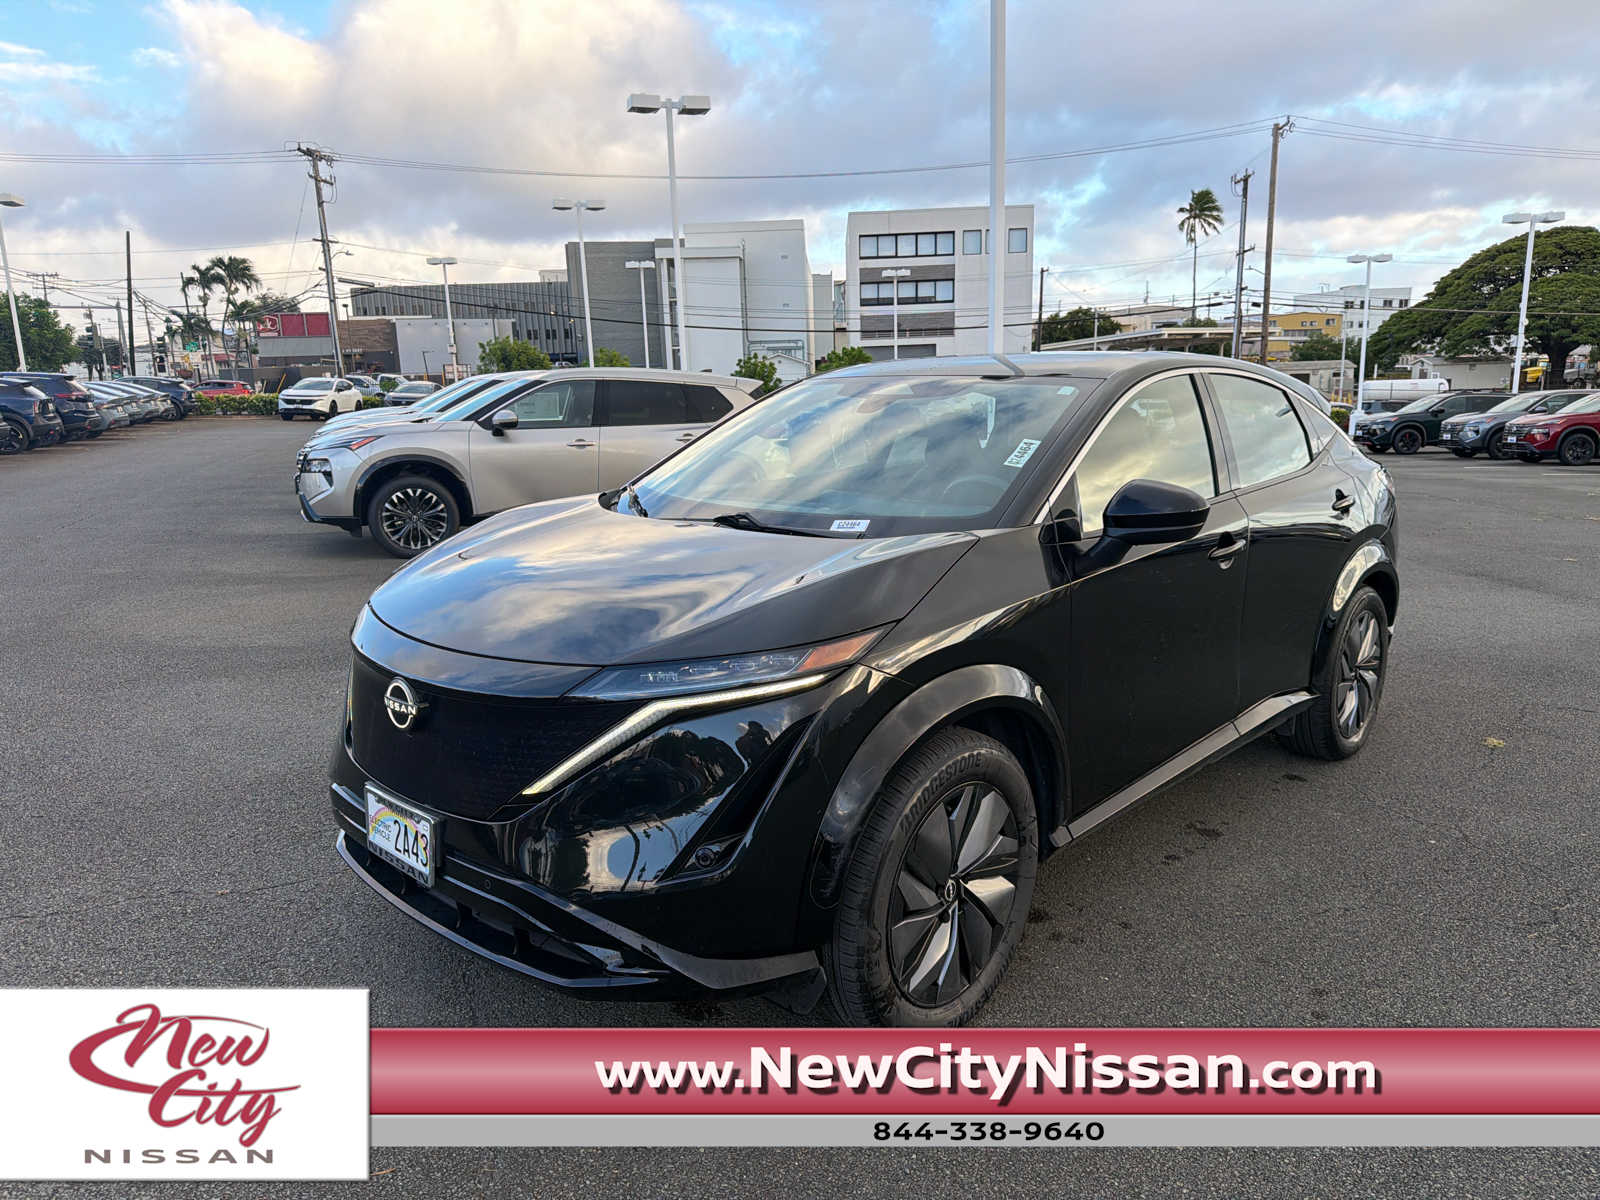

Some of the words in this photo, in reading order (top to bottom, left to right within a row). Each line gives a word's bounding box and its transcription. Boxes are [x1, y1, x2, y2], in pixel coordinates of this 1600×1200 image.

[384, 696, 417, 716] NISSAN
[368, 840, 430, 885] NISSAN
[393, 819, 429, 868] 2A43
